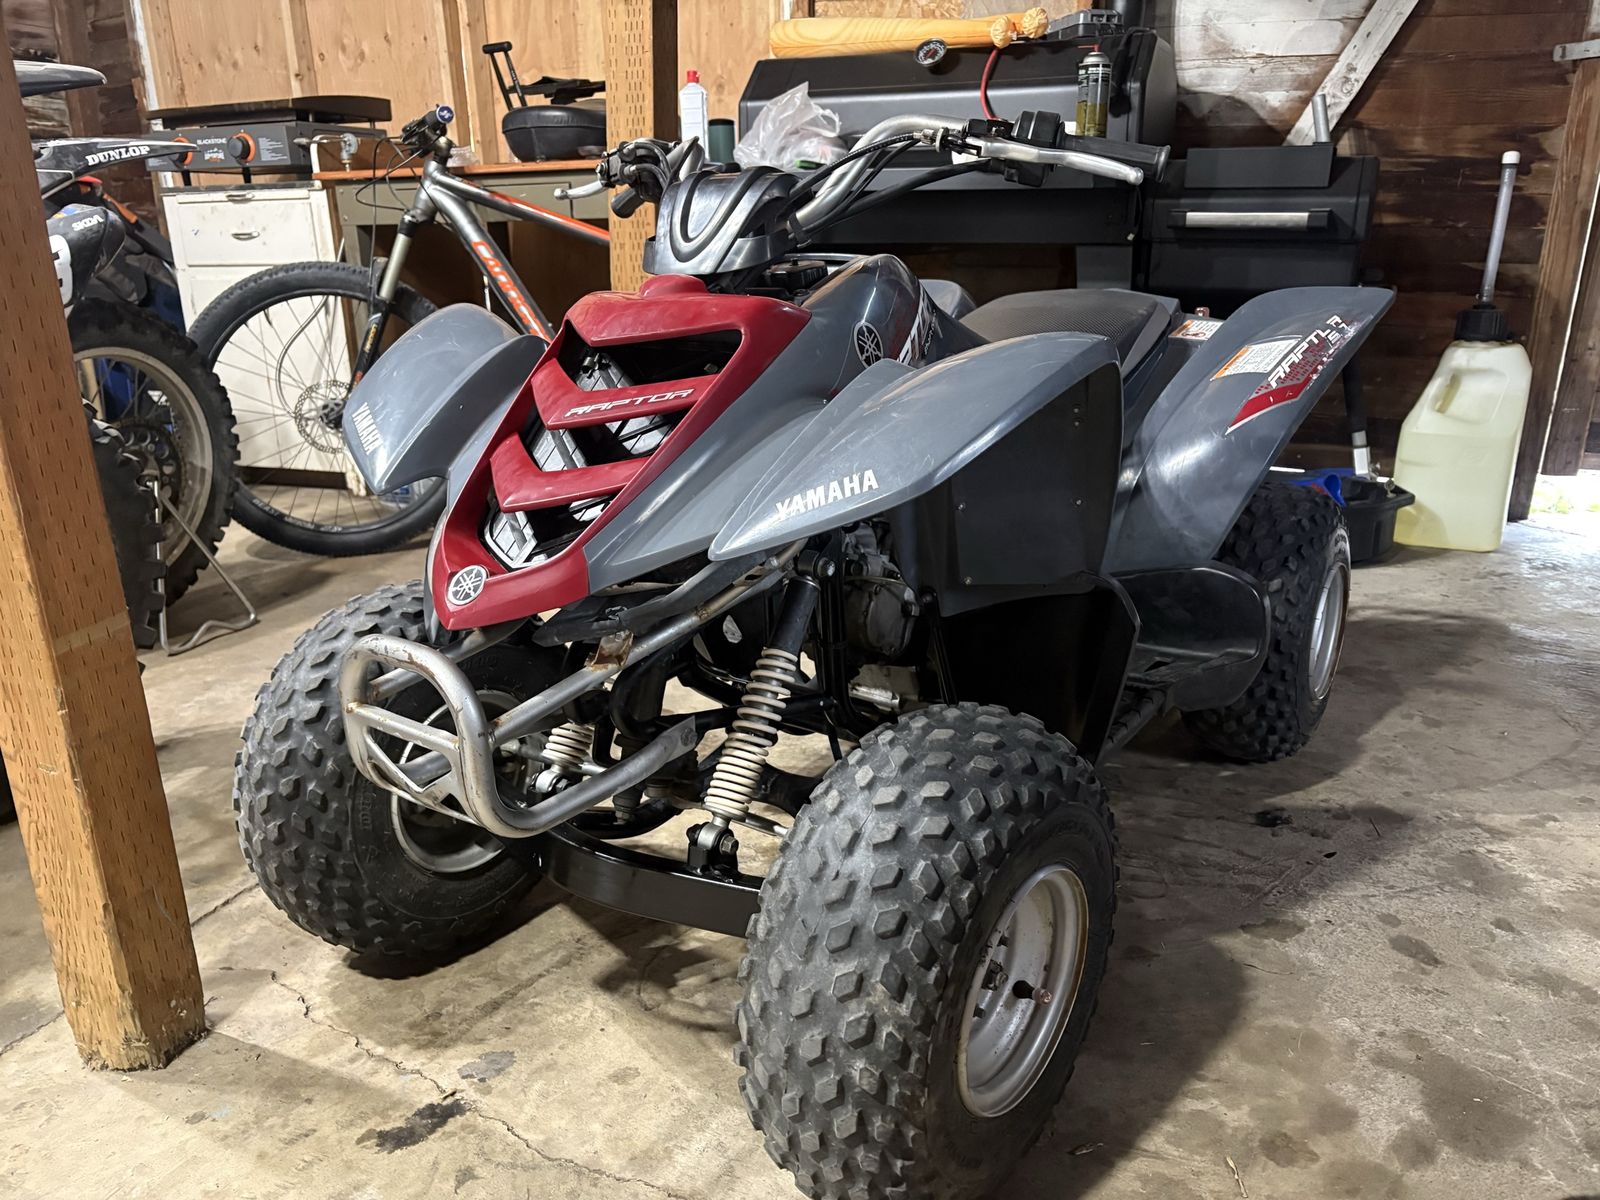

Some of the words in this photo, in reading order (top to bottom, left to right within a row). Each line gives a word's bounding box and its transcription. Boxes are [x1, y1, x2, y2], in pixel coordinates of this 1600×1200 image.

[85, 145, 150, 166] DUNLOP
[564, 388, 695, 418] RAPTOR
[351, 402, 384, 456] YAMAHA
[775, 469, 879, 520] YAMAHA
